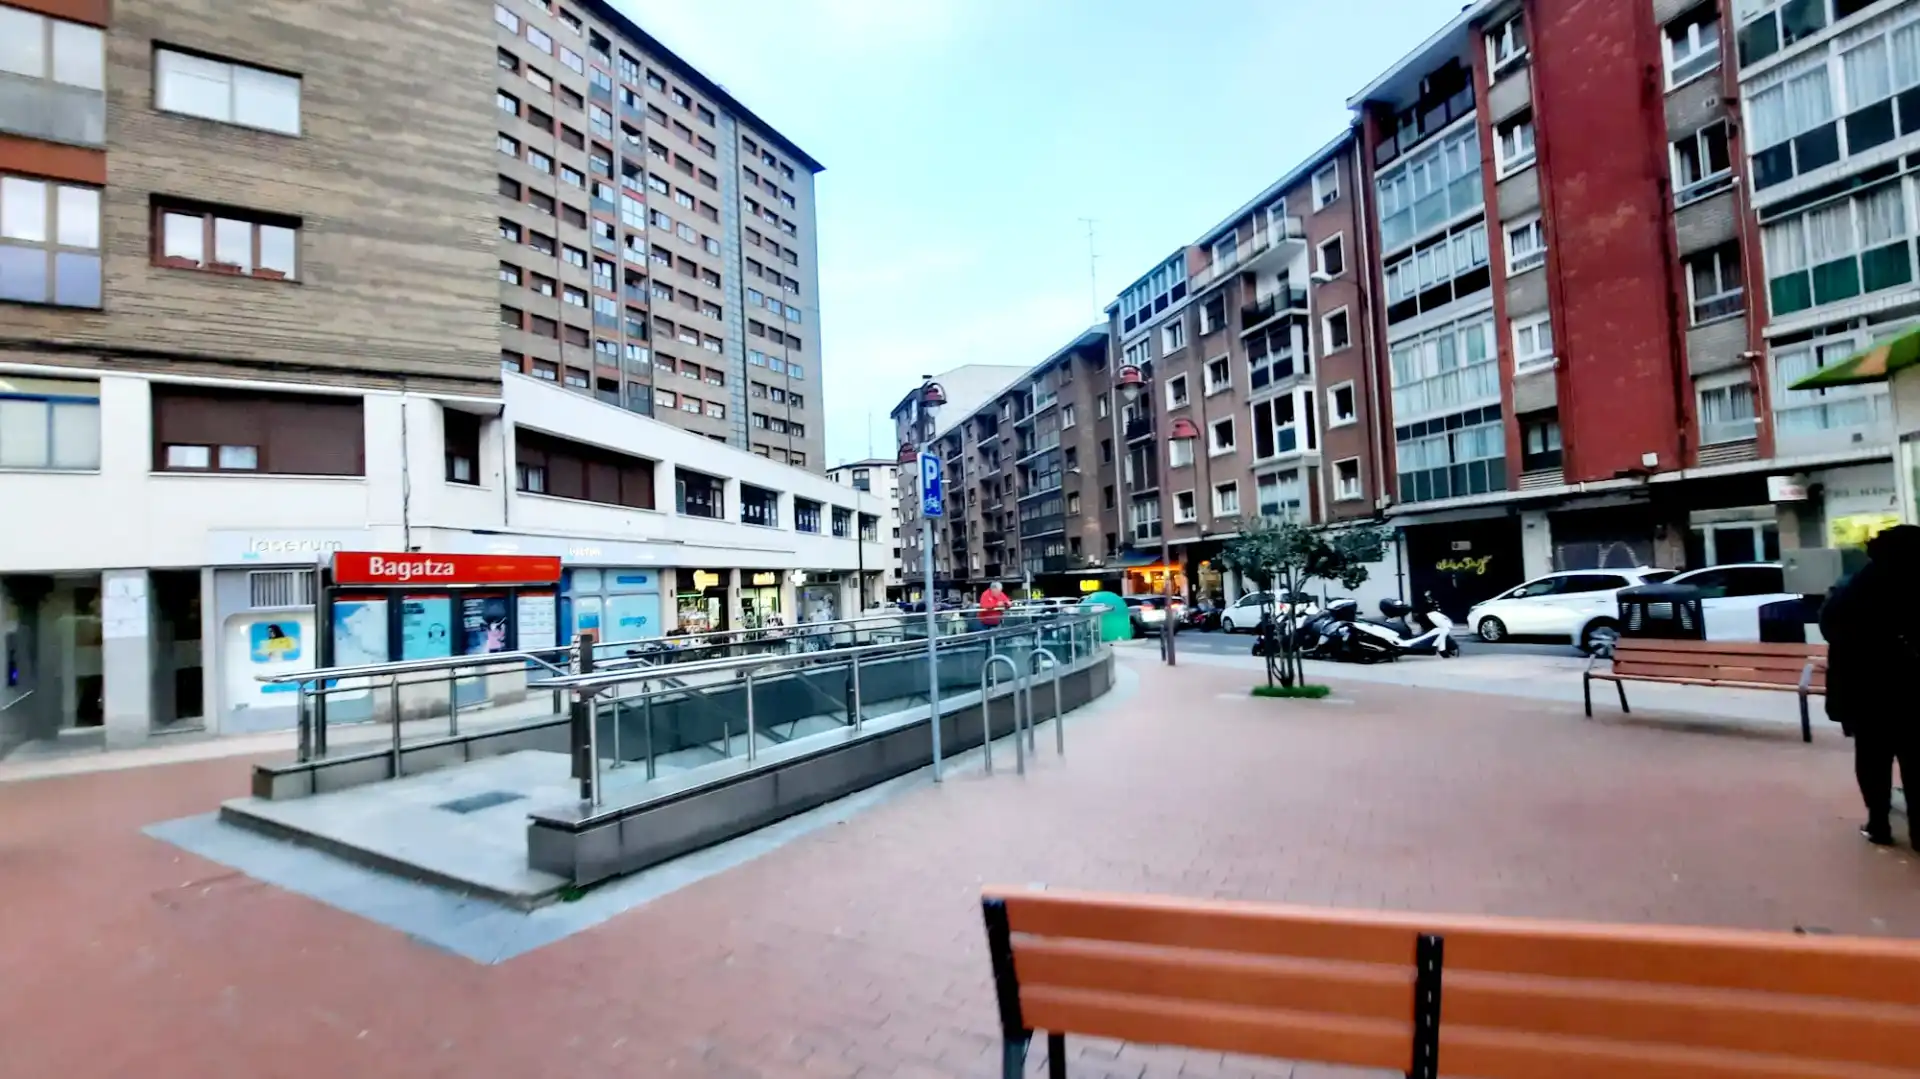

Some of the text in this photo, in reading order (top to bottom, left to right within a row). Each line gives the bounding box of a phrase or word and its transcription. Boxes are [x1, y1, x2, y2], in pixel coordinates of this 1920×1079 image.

[925, 459, 938, 489] P
[249, 537, 342, 552] laserum
[369, 556, 455, 581] Bagatza
